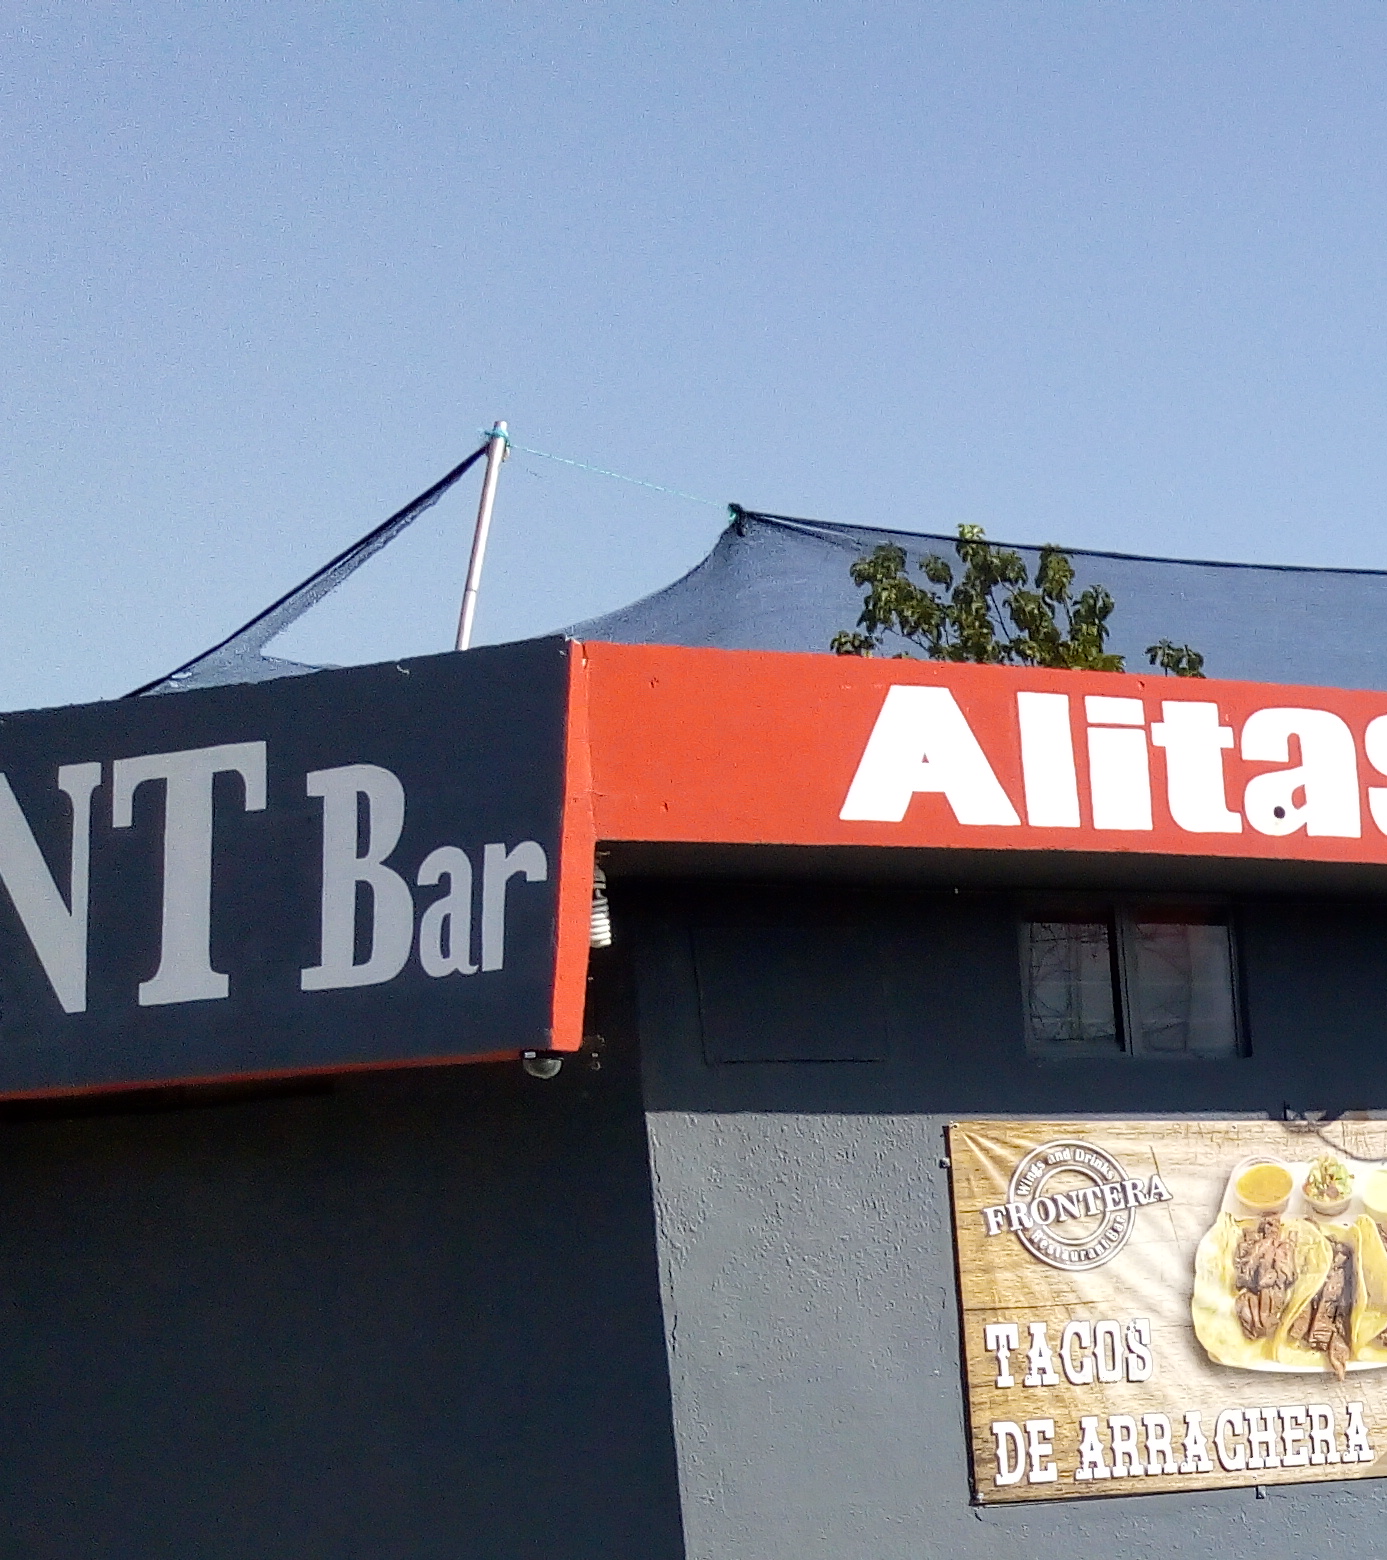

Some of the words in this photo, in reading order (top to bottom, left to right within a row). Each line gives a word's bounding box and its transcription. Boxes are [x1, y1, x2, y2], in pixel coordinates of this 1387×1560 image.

[300, 763, 548, 991] Bar
[1047, 1147, 1072, 1165] and
[1074, 1148, 1115, 1180] Drinks
[982, 1174, 1174, 1237] FRONTERA
[985, 1318, 1153, 1389] TACOS
[991, 1418, 1058, 1487] DE
[1075, 1401, 1375, 1482] ARRACHERA
